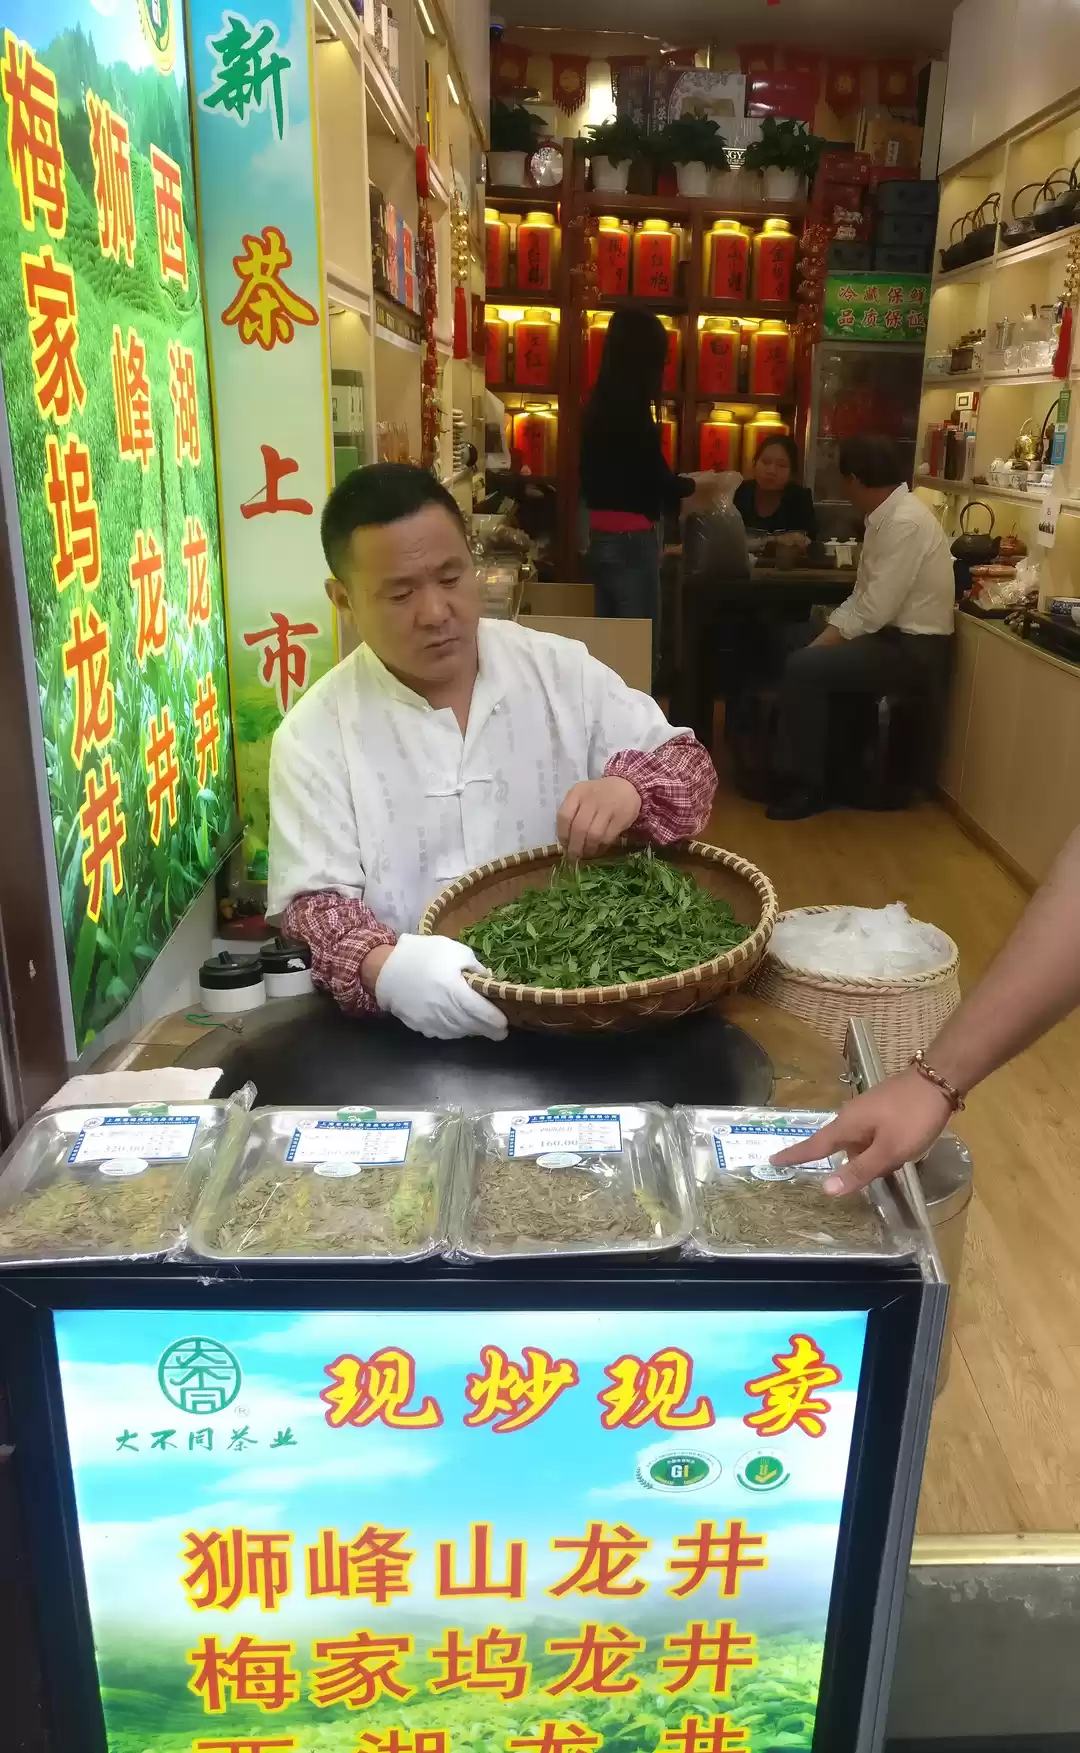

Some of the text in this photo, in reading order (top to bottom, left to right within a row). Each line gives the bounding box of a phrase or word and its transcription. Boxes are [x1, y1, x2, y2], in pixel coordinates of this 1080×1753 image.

[203, 16, 320, 713] 新茶上市
[2, 30, 127, 923] 梅家坞龙井
[86, 89, 180, 846] 狮峰龙井
[150, 143, 220, 790] 西湖龙井
[321, 1334, 842, 1438] 现炒现卖
[115, 1425, 298, 1452] 大不同茶业
[671, 1464, 689, 1478] GI
[183, 1521, 767, 1611] 狮峰山龙井
[190, 1621, 757, 1710] 梅家坞龙井
